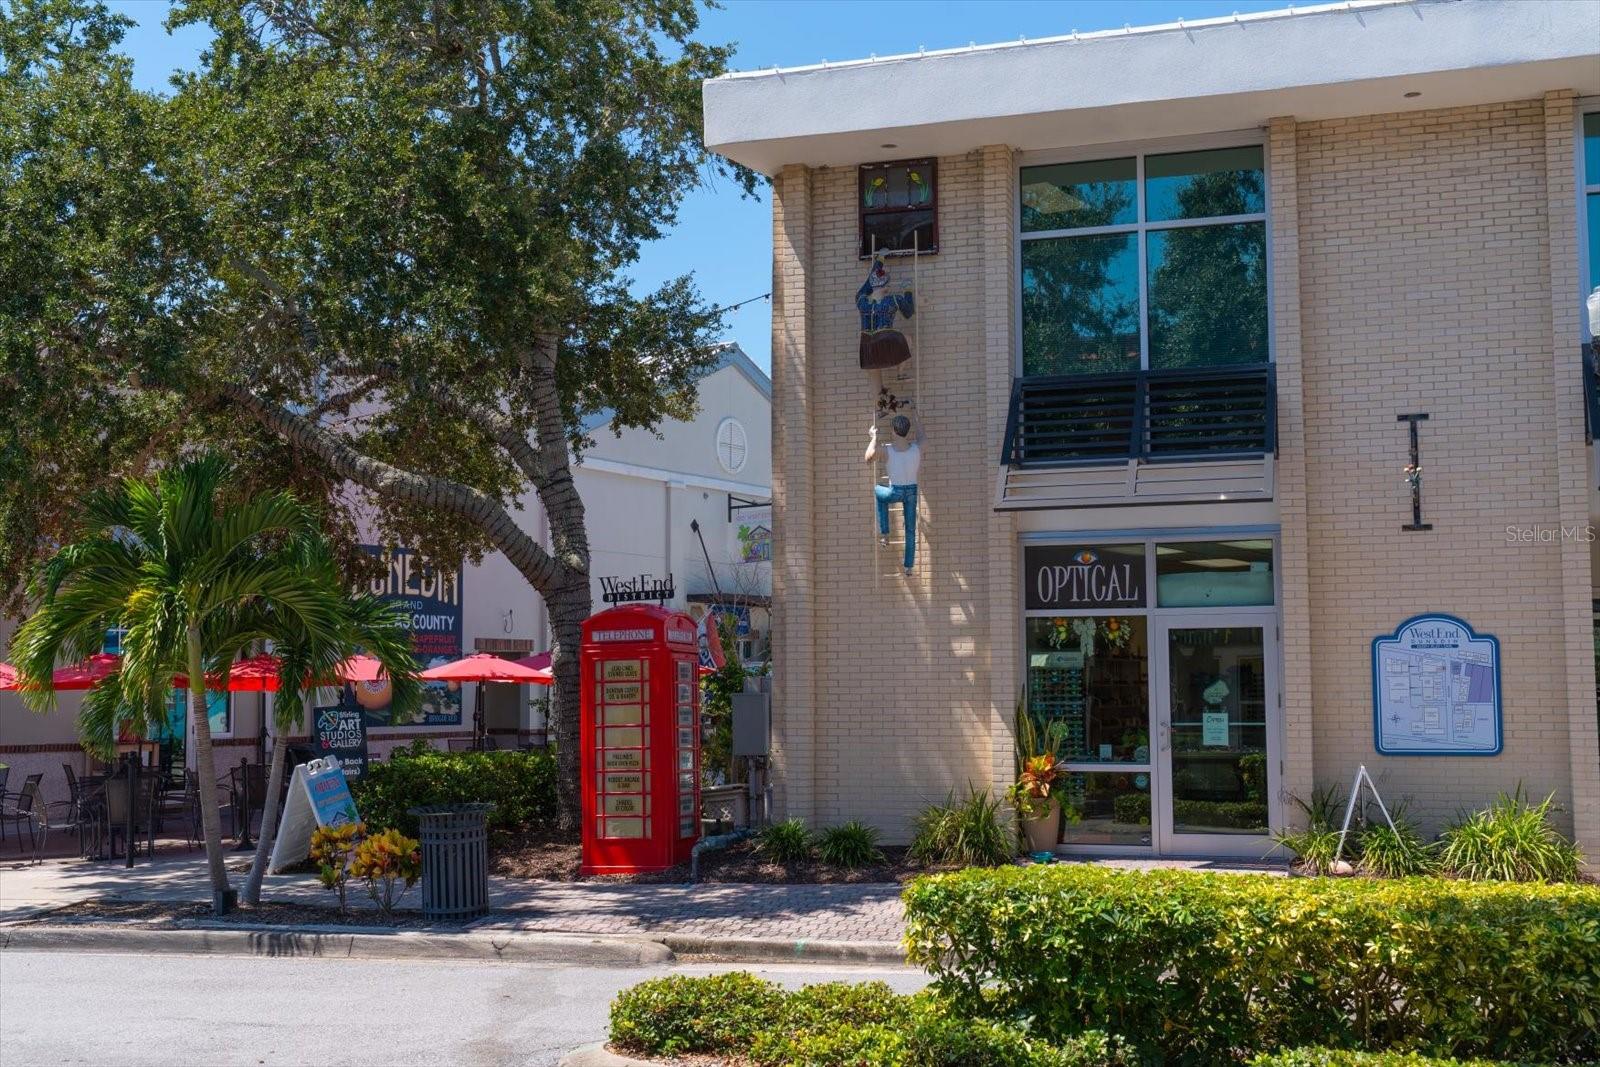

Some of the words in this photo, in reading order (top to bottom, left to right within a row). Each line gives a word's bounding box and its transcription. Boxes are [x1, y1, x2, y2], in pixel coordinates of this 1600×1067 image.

[1037, 564, 1139, 603] OPTICAL
[607, 591, 670, 601] DISTRICT
[412, 614, 455, 631] COUNTY
[598, 630, 651, 640] TELEPHONE
[338, 718, 362, 731] ART
[319, 729, 362, 741] STUDIOS
[329, 738, 362, 749] GALLERY
[344, 757, 364, 765] Back
